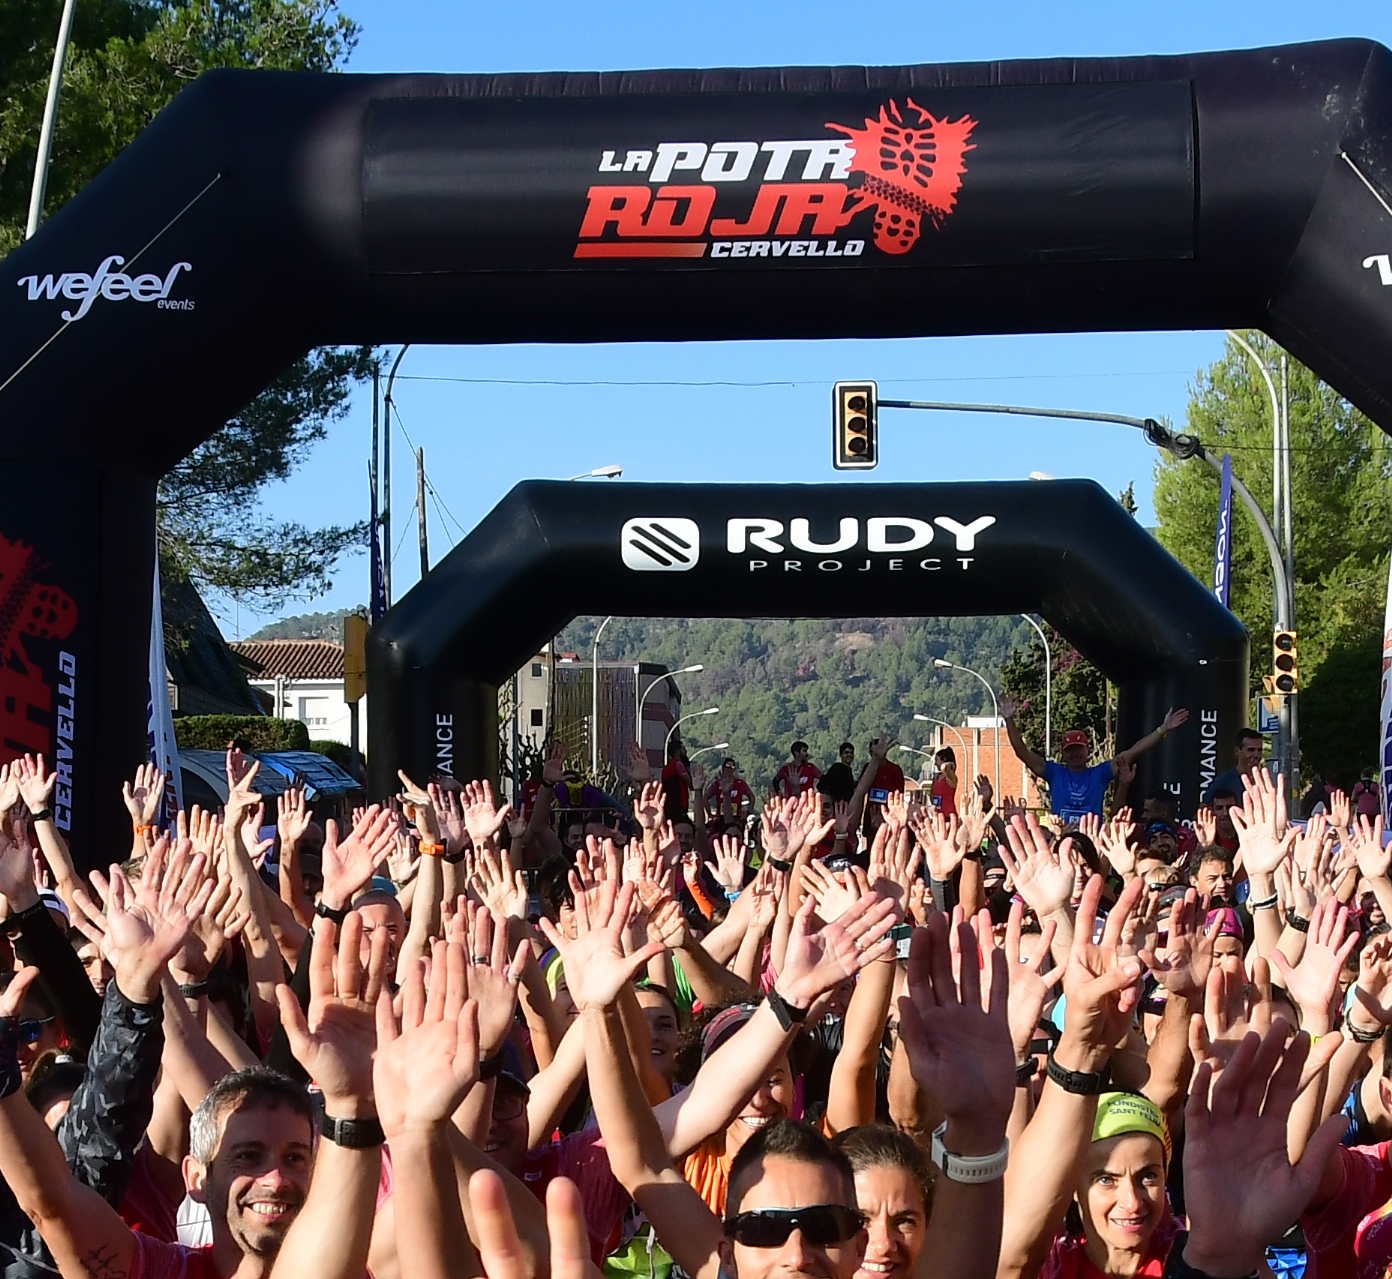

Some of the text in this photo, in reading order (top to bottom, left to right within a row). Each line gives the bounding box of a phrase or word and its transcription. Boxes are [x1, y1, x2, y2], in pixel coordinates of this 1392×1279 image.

[598, 139, 857, 183] LA POTA
[578, 183, 850, 238] ROJA
[710, 239, 865, 258] CERVELLO
[17, 255, 193, 322] wefeel
[157, 298, 196, 311] events
[726, 515, 997, 554] RUDY
[749, 557, 975, 572] PROJECT
[54, 650, 77, 832] CERVELLO
[436, 713, 453, 780] ANCE
